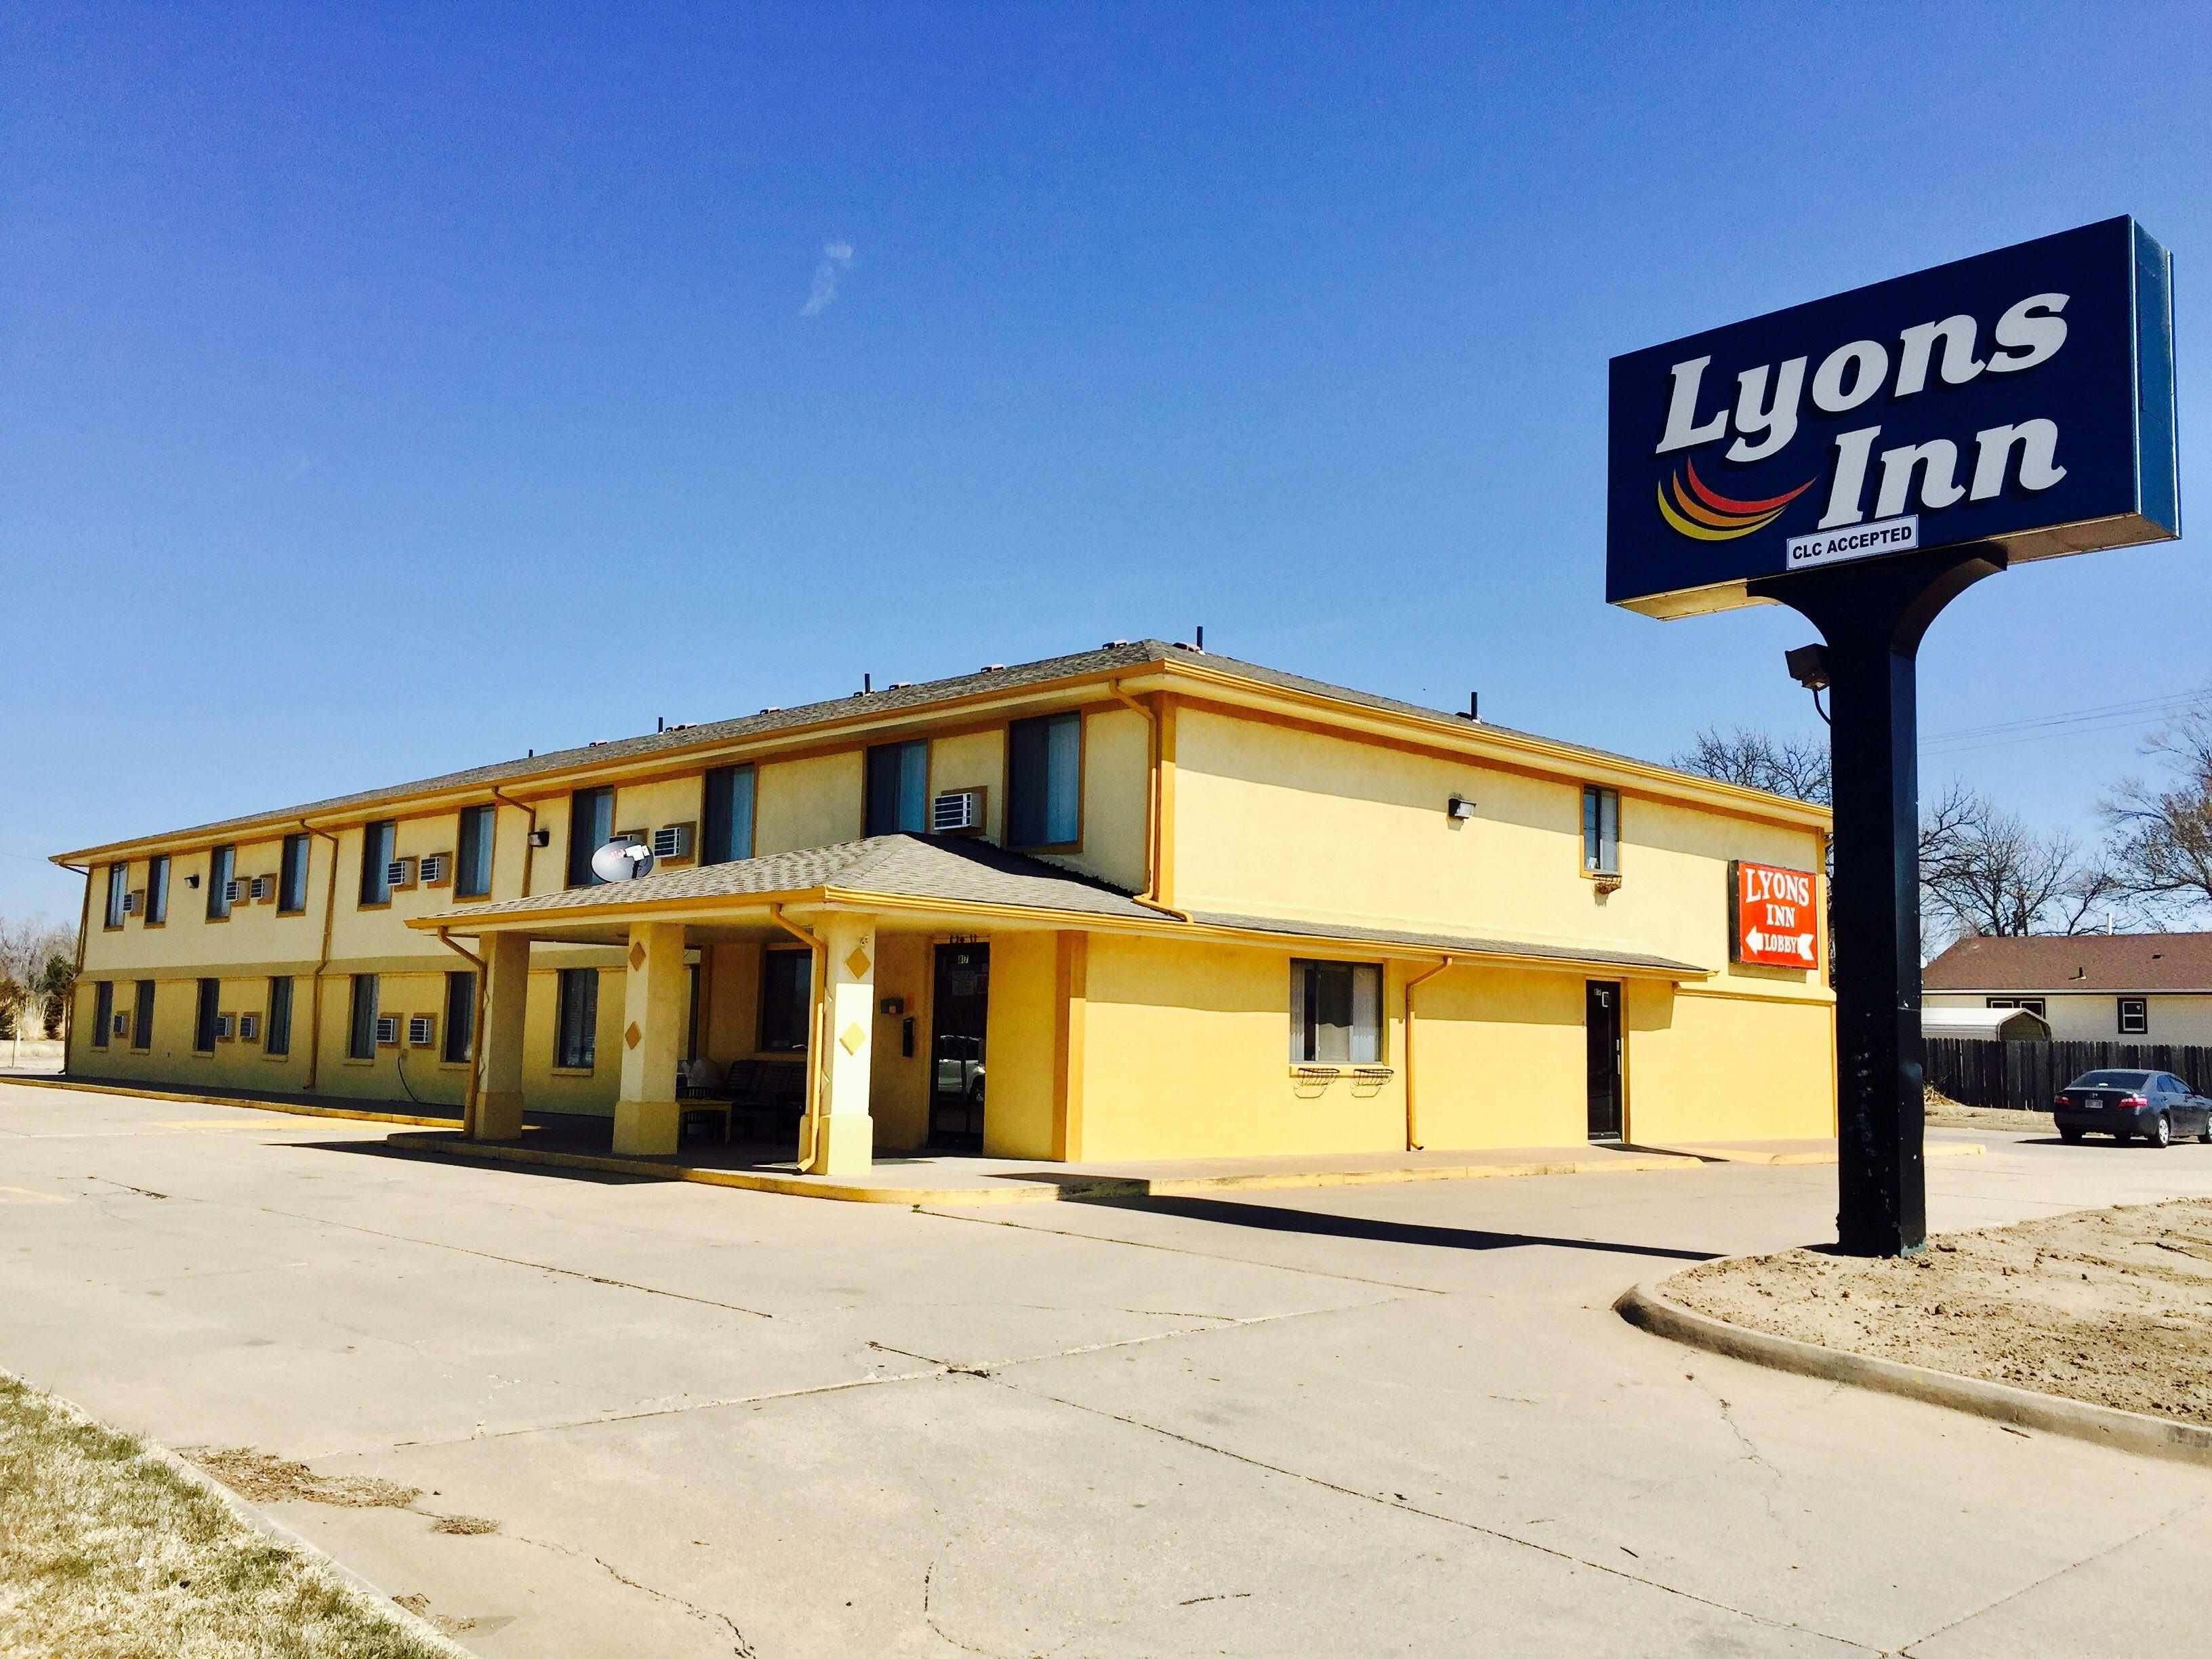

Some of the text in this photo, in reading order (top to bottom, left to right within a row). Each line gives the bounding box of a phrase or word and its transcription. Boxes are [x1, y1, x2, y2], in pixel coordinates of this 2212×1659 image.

[1656, 293, 2070, 462] Lyons
[1818, 418, 2067, 530] Inn
[1793, 526, 1912, 560] CLC ACCEPTED
[1745, 867, 1809, 907] LYONS
[1765, 903, 1795, 928] INN
[1763, 933, 1799, 954] LOBBY
